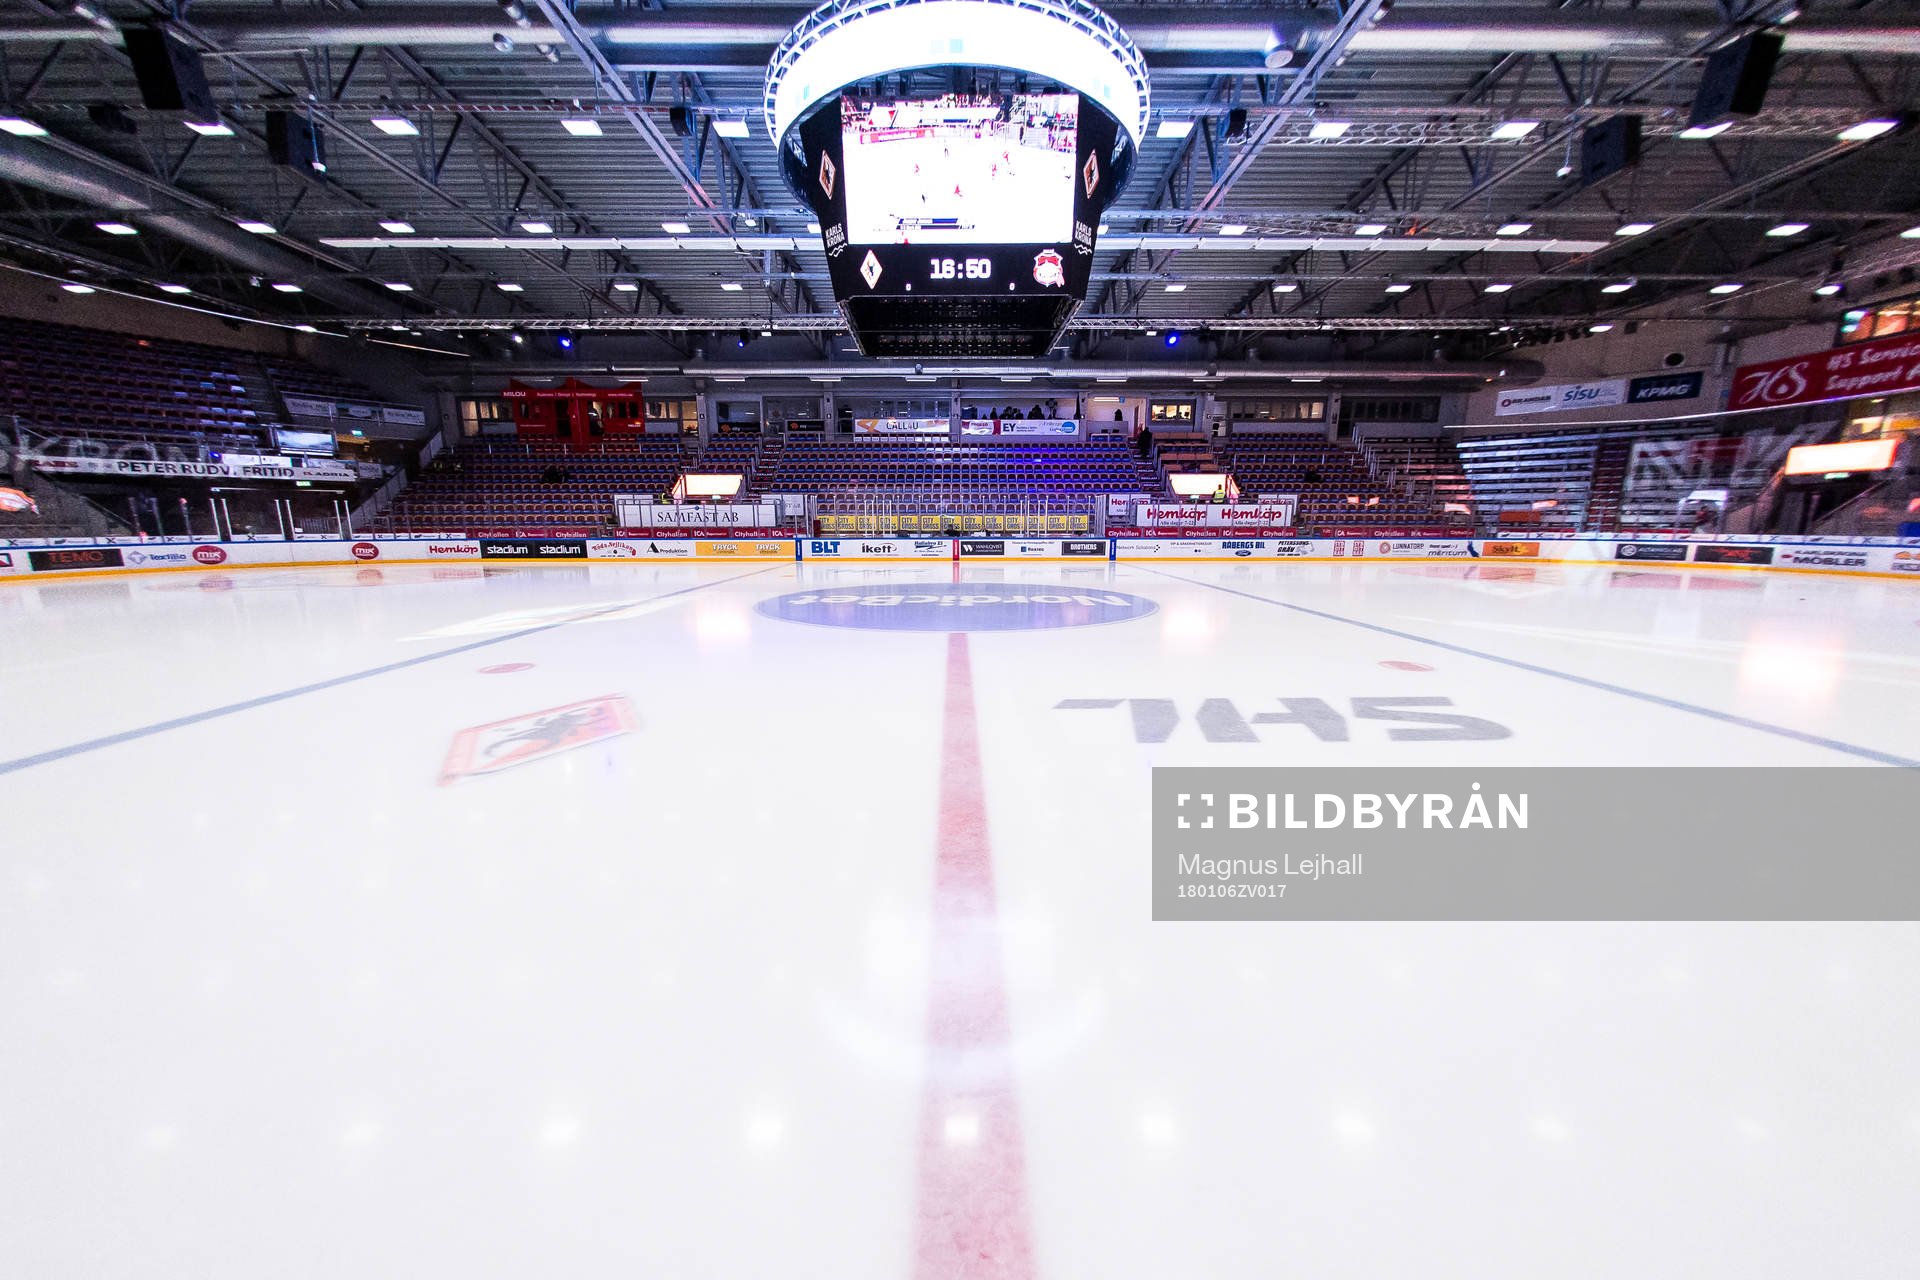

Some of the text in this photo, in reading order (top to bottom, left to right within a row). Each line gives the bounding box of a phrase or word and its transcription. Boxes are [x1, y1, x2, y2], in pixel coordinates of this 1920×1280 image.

[825, 223, 843, 238] KARLS
[1076, 220, 1092, 237] KARLS
[826, 232, 845, 248] KRONA
[1075, 231, 1092, 247] KRONA
[930, 258, 992, 279] 16:50
[906, 283, 912, 291] 0
[1009, 283, 1015, 291] 0
[1824, 364, 1904, 391] Support
[1635, 383, 1692, 399] KPMG
[1003, 423, 1017, 432] EY
[118, 461, 177, 474] PETER
[657, 512, 739, 523] SAMFAST AB
[1147, 508, 1207, 521] Hemköp
[1221, 508, 1282, 521] Hemköp
[429, 544, 478, 554] Hemköp
[487, 545, 529, 554] stadium
[540, 545, 581, 554] stadium
[811, 541, 840, 553] BLT
[1221, 541, 1254, 549] RÅBERGS
[1255, 541, 1265, 549] BIL
[47, 550, 104, 564] TEMO
[789, 594, 1132, 607] NordicBet
[1052, 697, 1514, 743] SHL
